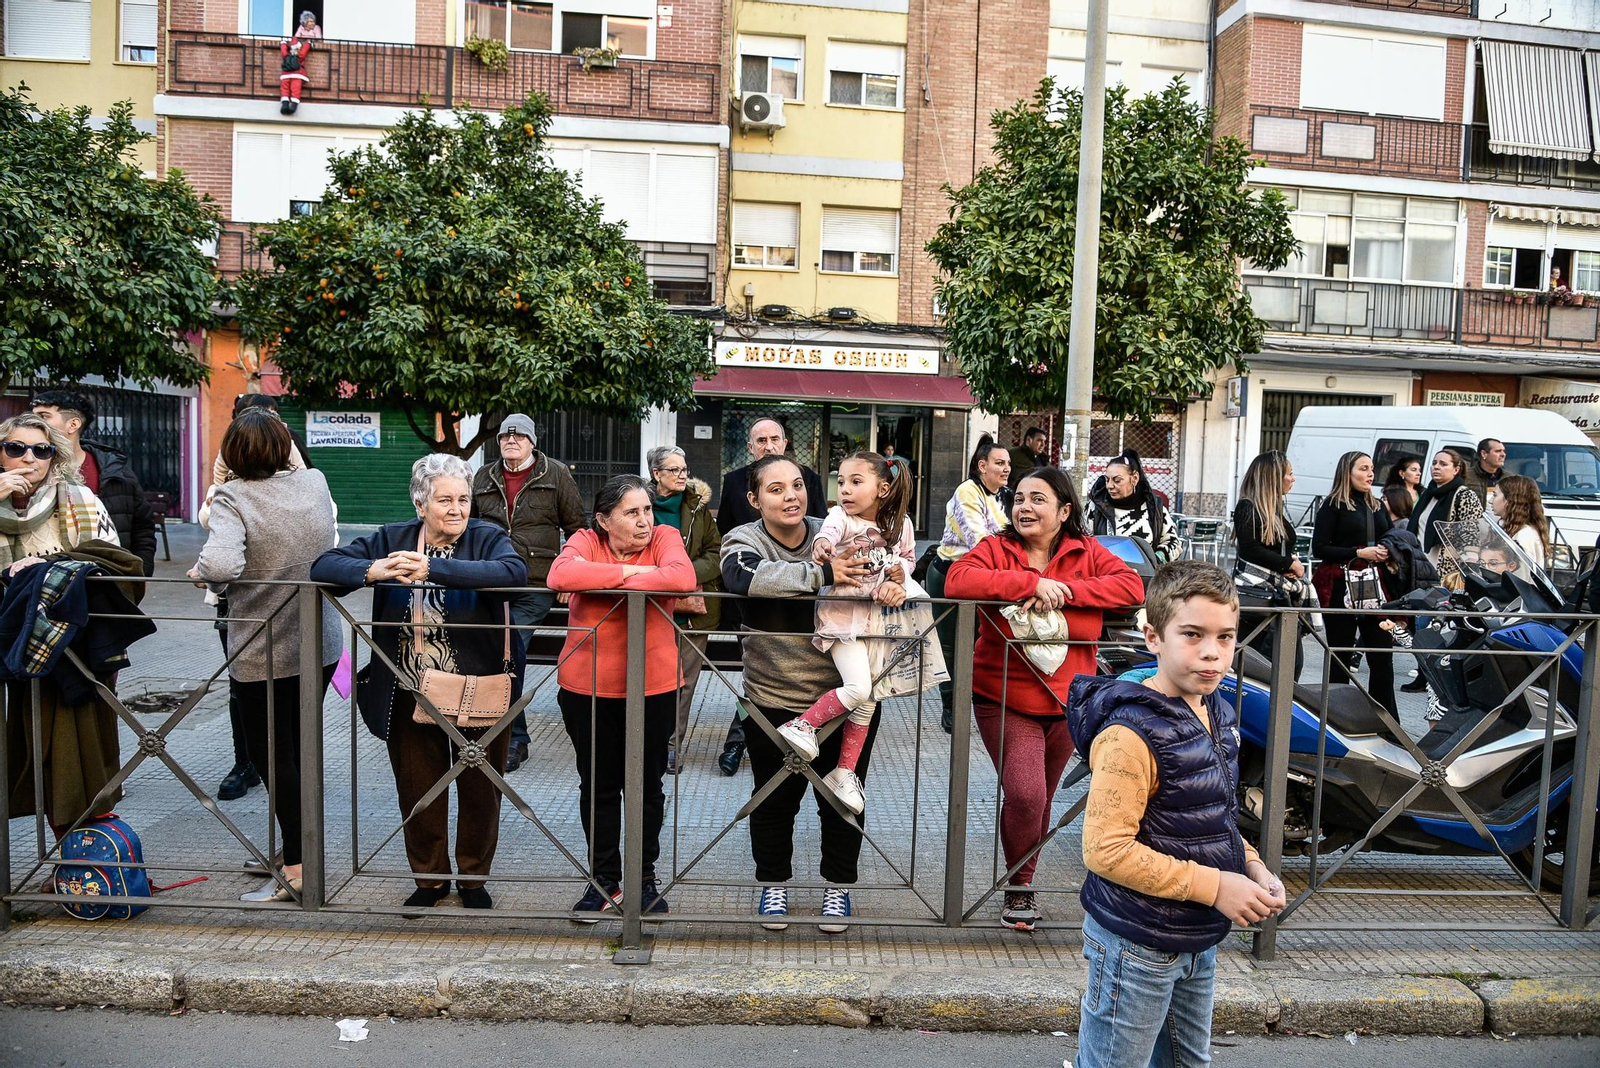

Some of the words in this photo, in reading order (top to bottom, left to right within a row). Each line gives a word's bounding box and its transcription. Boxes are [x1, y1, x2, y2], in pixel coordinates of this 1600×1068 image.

[744, 346, 822, 364] MODAS
[834, 350, 908, 368] OSHUN
[1430, 392, 1472, 402] PERSIANAS
[1473, 394, 1501, 403] RIVERA
[1530, 393, 1600, 405] Restaurante
[313, 412, 372, 424] Lacolada
